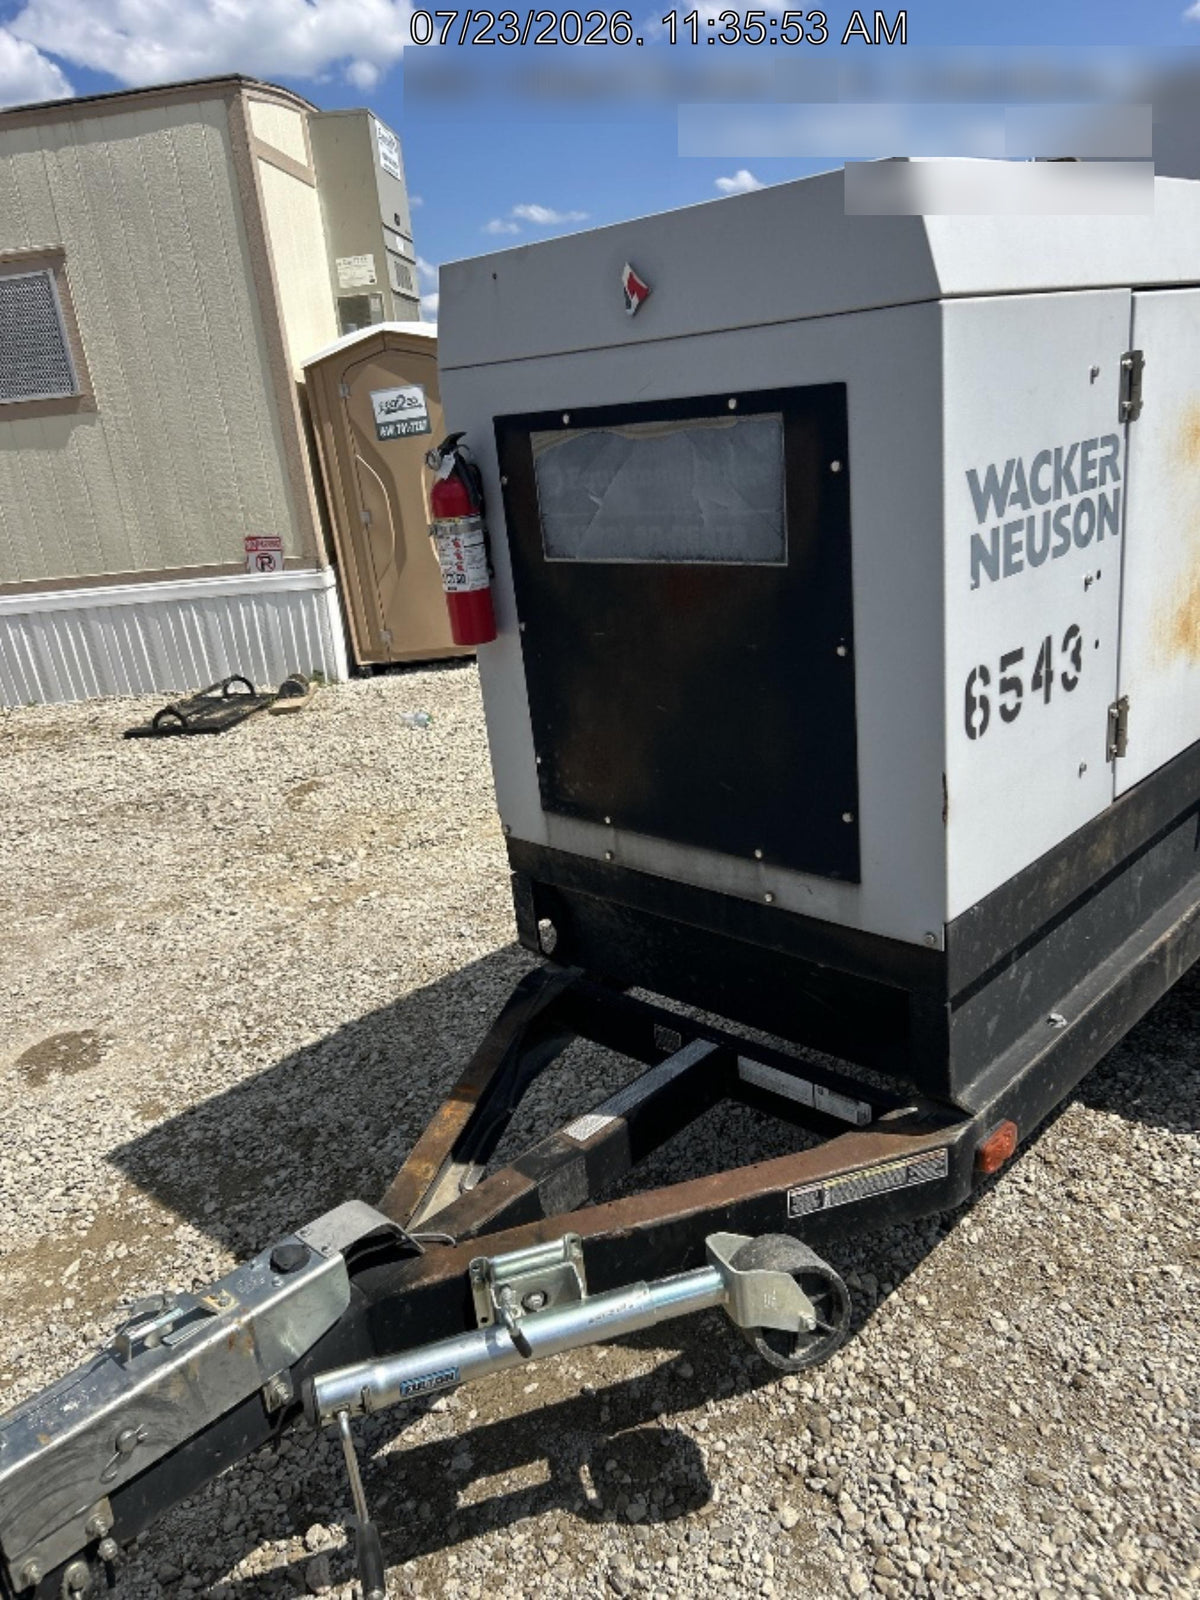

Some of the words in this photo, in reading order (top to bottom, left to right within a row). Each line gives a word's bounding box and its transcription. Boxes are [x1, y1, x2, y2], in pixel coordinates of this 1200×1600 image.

[965, 433, 1121, 524] WACKER
[970, 487, 1121, 591] NEUSON
[965, 624, 1082, 740] 6543
